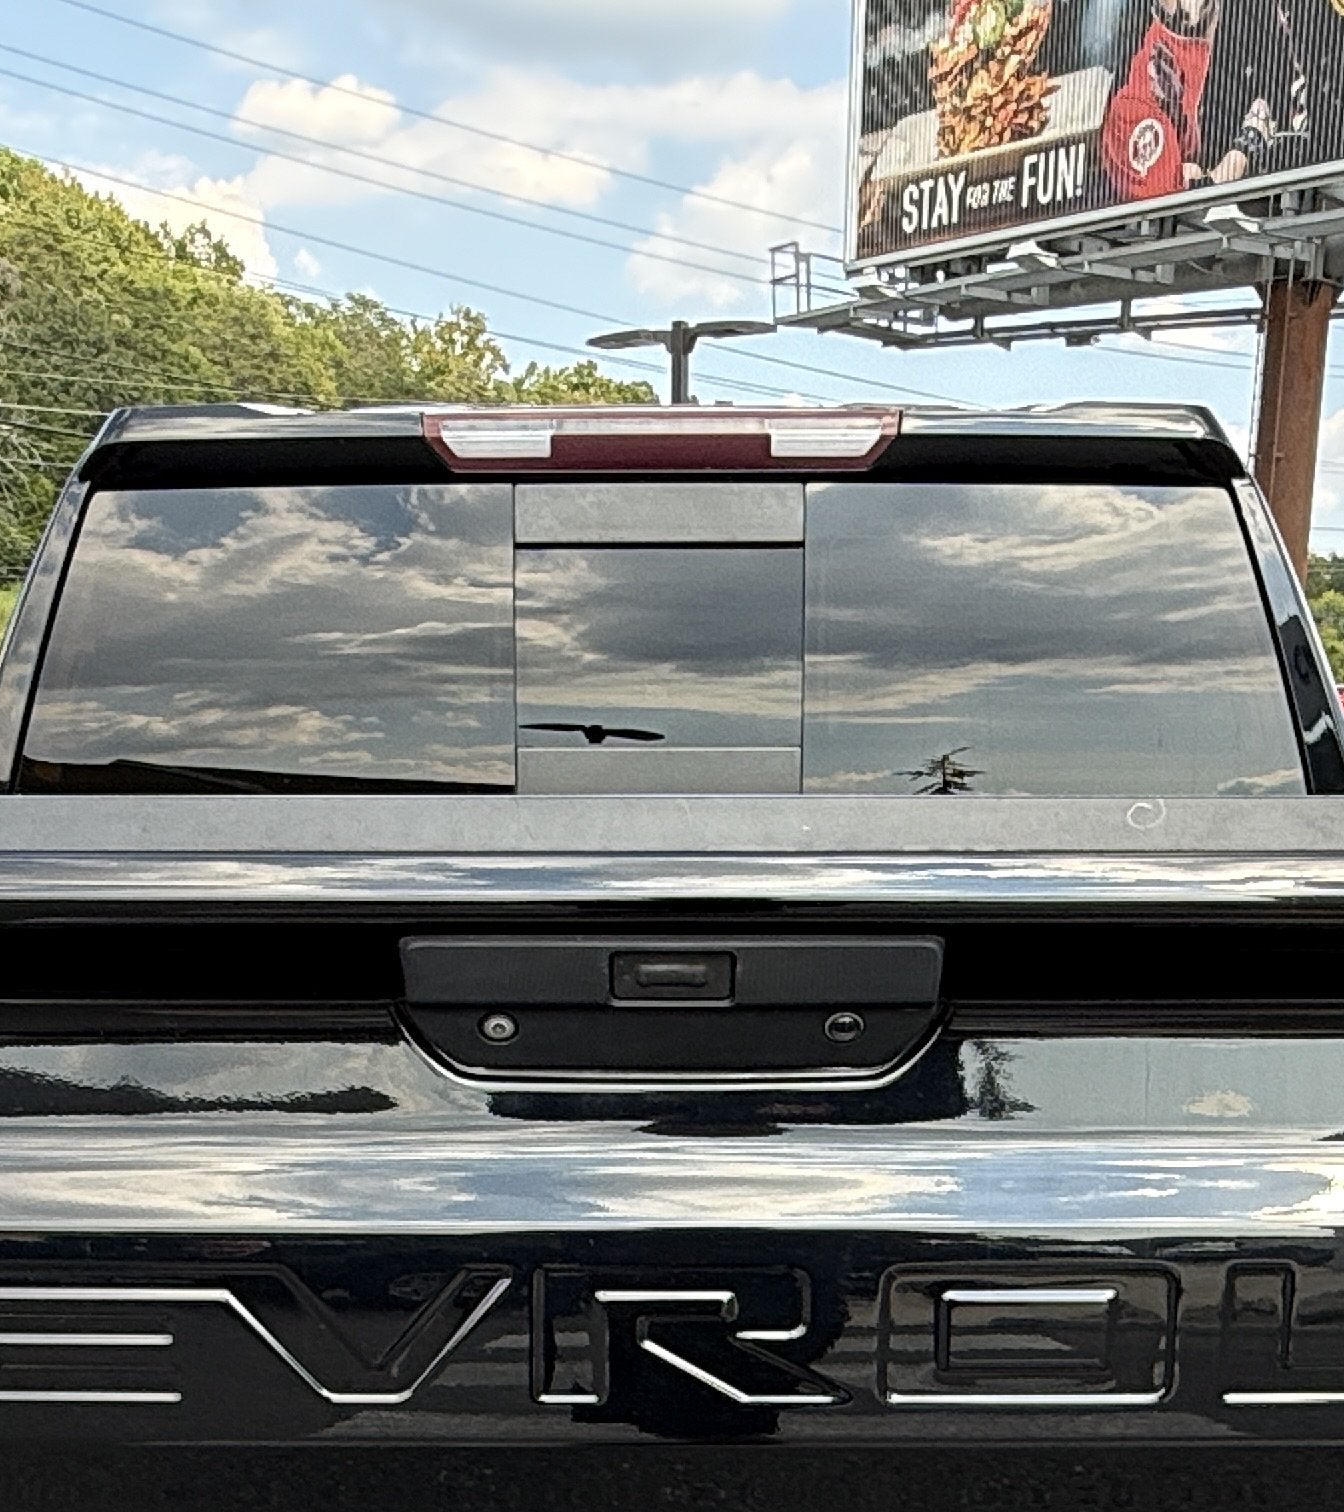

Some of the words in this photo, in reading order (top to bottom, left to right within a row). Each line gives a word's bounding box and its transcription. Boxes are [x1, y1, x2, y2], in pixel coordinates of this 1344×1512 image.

[902, 170, 966, 234] STAY
[966, 183, 990, 210] FOR
[992, 176, 1017, 205] THE
[1020, 142, 1086, 209] FUN!
